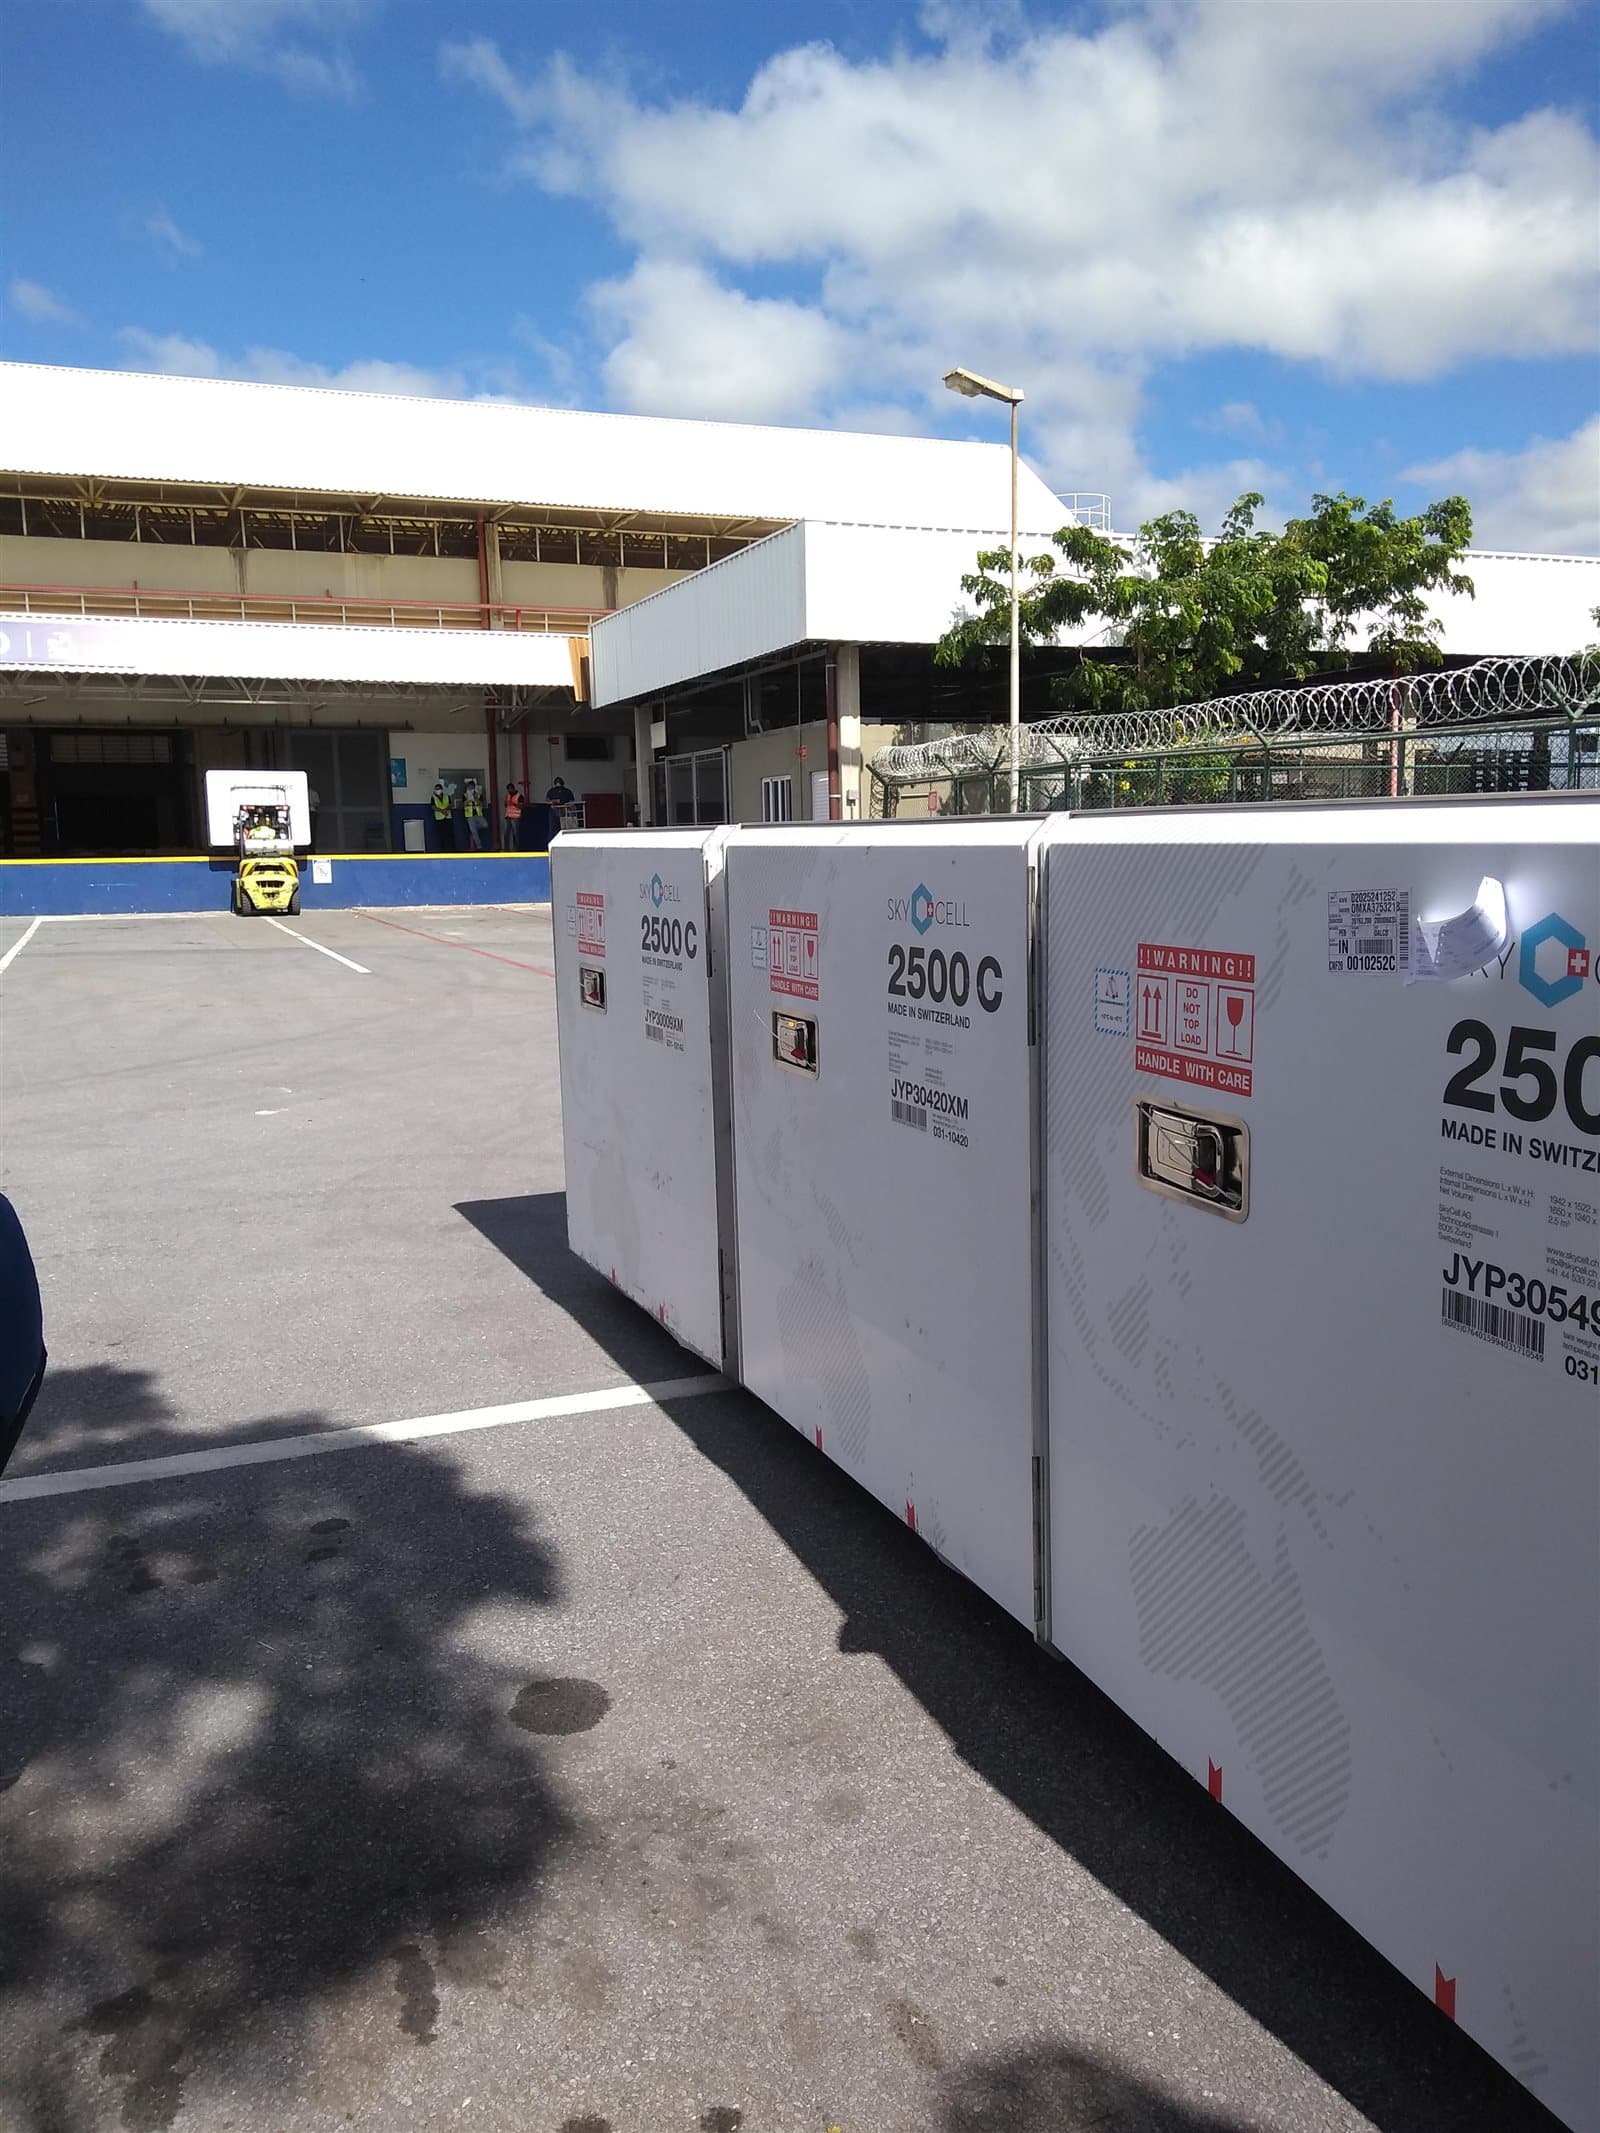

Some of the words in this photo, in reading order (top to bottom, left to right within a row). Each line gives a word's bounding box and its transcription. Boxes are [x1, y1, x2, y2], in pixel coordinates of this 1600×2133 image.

[888, 898, 910, 921] SKY
[935, 901, 970, 927] CELL
[641, 915, 683, 957] 2500
[685, 921, 697, 959] C
[1339, 940, 1349, 954] IN
[1139, 948, 1251, 978] !!WARNING!!
[1346, 955, 1396, 971] 0010252C
[888, 944, 970, 1007] 2500
[976, 955, 1003, 1013] C
[1186, 987, 1198, 999] DO
[888, 1001, 907, 1017] MADE
[908, 1006, 916, 1018] IN
[917, 1007, 971, 1029] SWITZERLAND
[1183, 1002, 1201, 1015] NOT
[1183, 1018, 1200, 1030] TOP
[1180, 1033, 1202, 1046] LOAD
[1137, 1050, 1180, 1074] HANDLE
[1185, 1061, 1214, 1082] WITH
[1217, 1070, 1250, 1090] CARE
[891, 1078, 969, 1120] JYP30420XM
[933, 1125, 969, 1148] 031-10420
[1441, 1118, 1497, 1148] MADE
[1502, 1131, 1522, 1155] IN
[1565, 1355, 1598, 1385] 031
